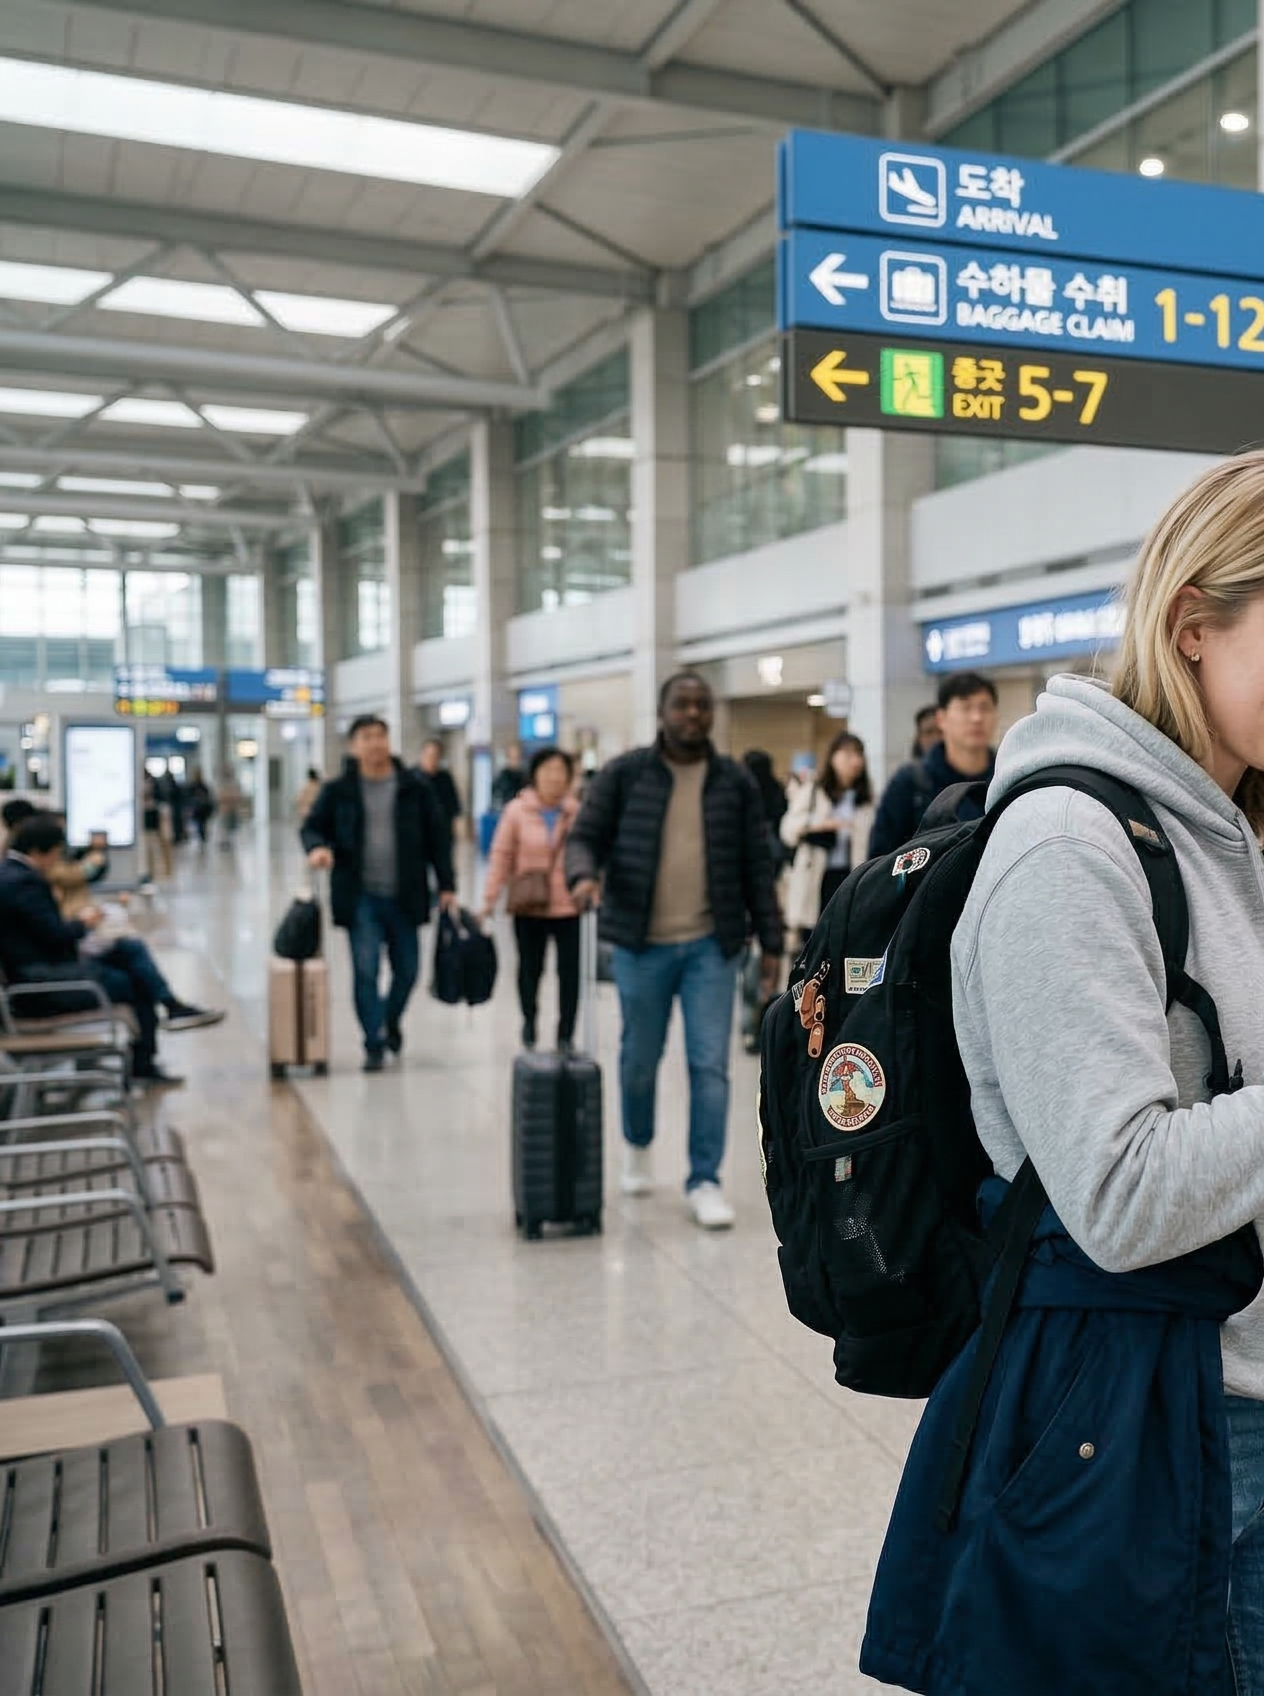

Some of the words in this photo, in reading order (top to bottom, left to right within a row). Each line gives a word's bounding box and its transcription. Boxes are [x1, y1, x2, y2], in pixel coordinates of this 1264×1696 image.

[955, 164, 1025, 208] 도착
[956, 204, 1059, 240] ARRIVAL
[956, 301, 1064, 336] BAGGAGE
[1066, 313, 1135, 343] CLAIM
[952, 392, 1005, 420] EXIT
[1018, 364, 1108, 425] 5-7
